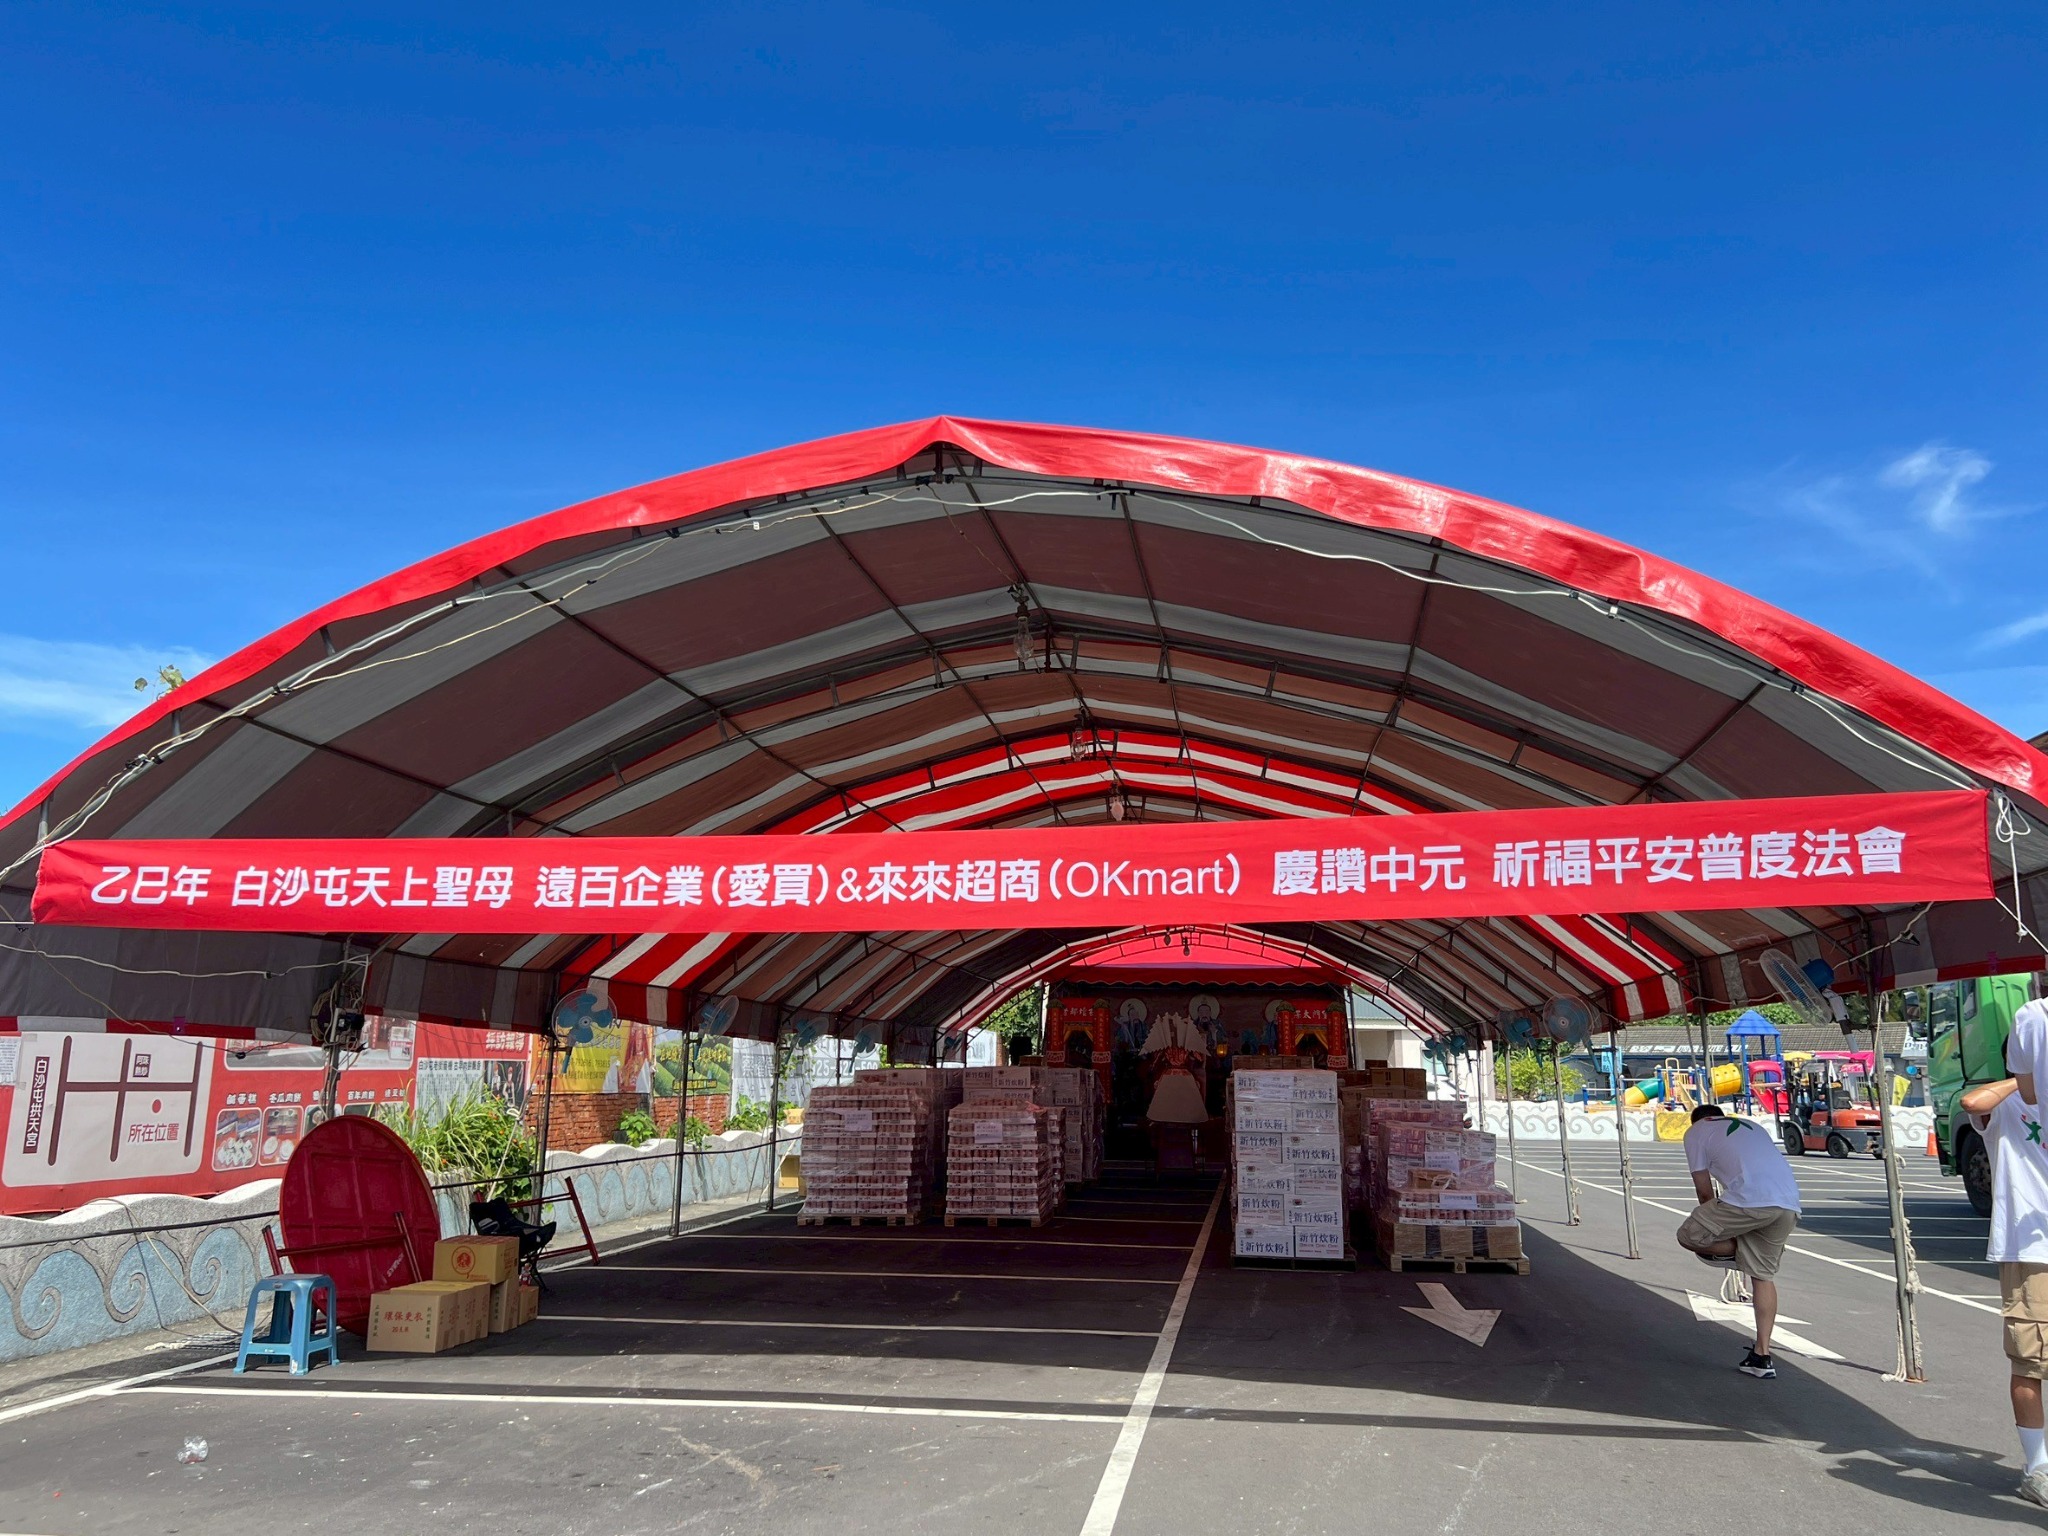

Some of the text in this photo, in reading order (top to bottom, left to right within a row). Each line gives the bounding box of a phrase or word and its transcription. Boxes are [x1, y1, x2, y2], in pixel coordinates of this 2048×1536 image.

[90, 826, 1906, 910] 乙巳年 白沙屯天上聖母 遠百企業(愛買)&來來超商(OKmart) 慶讚中元 祈福平安普度法會
[26, 1059, 48, 1148] 白沙屯拱天宮
[127, 1123, 180, 1143] 所在位置
[1240, 1136, 1278, 1146] 新竹炊粉
[1292, 1149, 1331, 1160] 新竹炊粉
[1242, 1198, 1280, 1209] 新竹炊粉
[1294, 1212, 1333, 1223] 新竹炊粉
[1300, 1233, 1339, 1244] 新竹炊粉
[1245, 1241, 1285, 1253] 新竹炊粉
